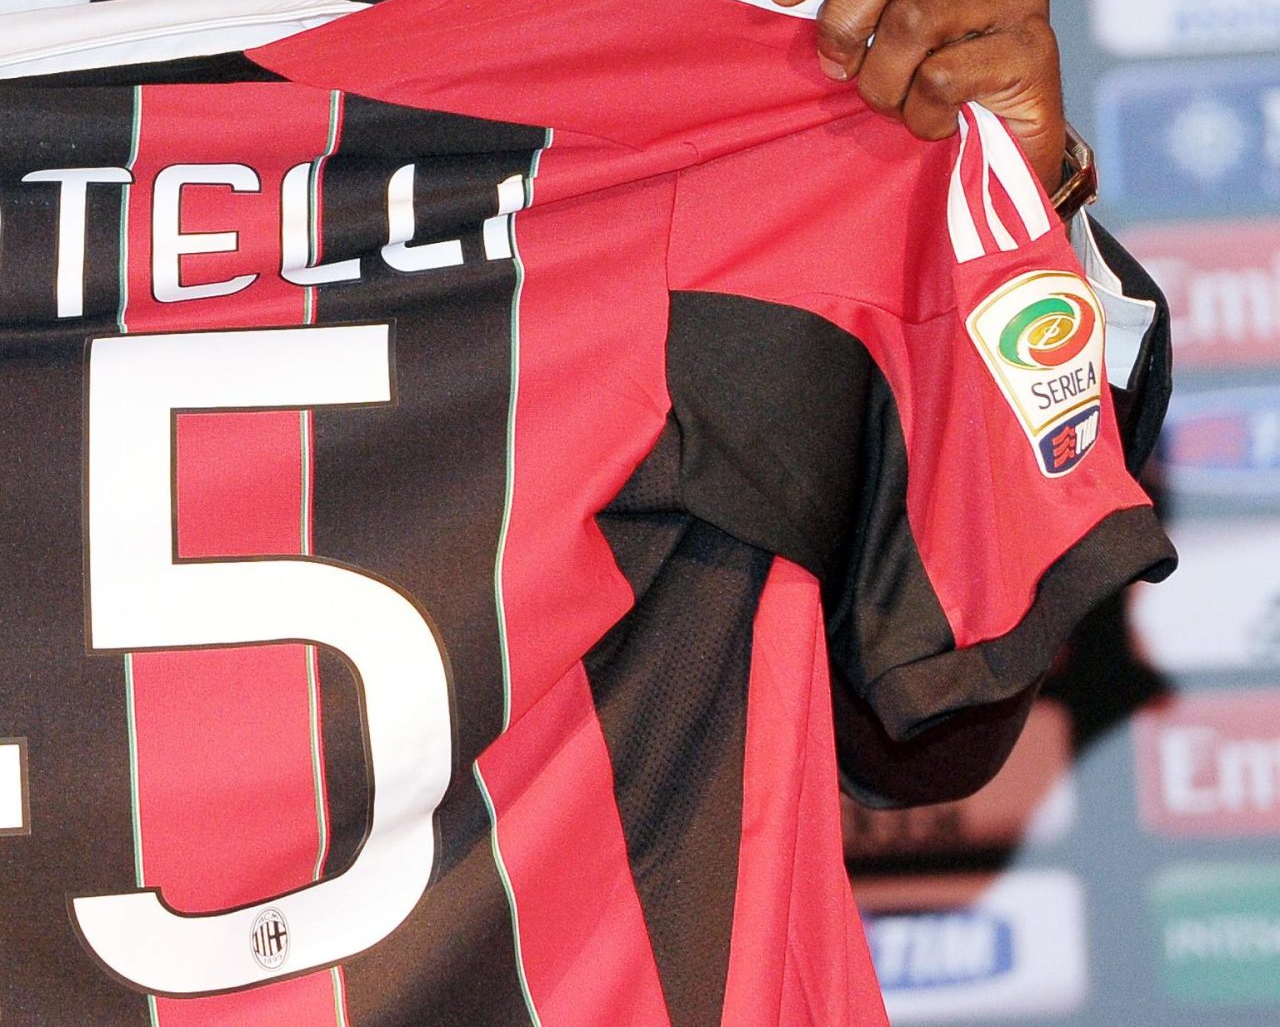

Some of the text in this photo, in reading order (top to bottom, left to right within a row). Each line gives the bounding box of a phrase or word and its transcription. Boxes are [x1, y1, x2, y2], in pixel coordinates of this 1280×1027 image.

[1152, 246, 1280, 344] Em
[1030, 360, 1097, 410] SERIE A
[1074, 410, 1099, 455] TIM
